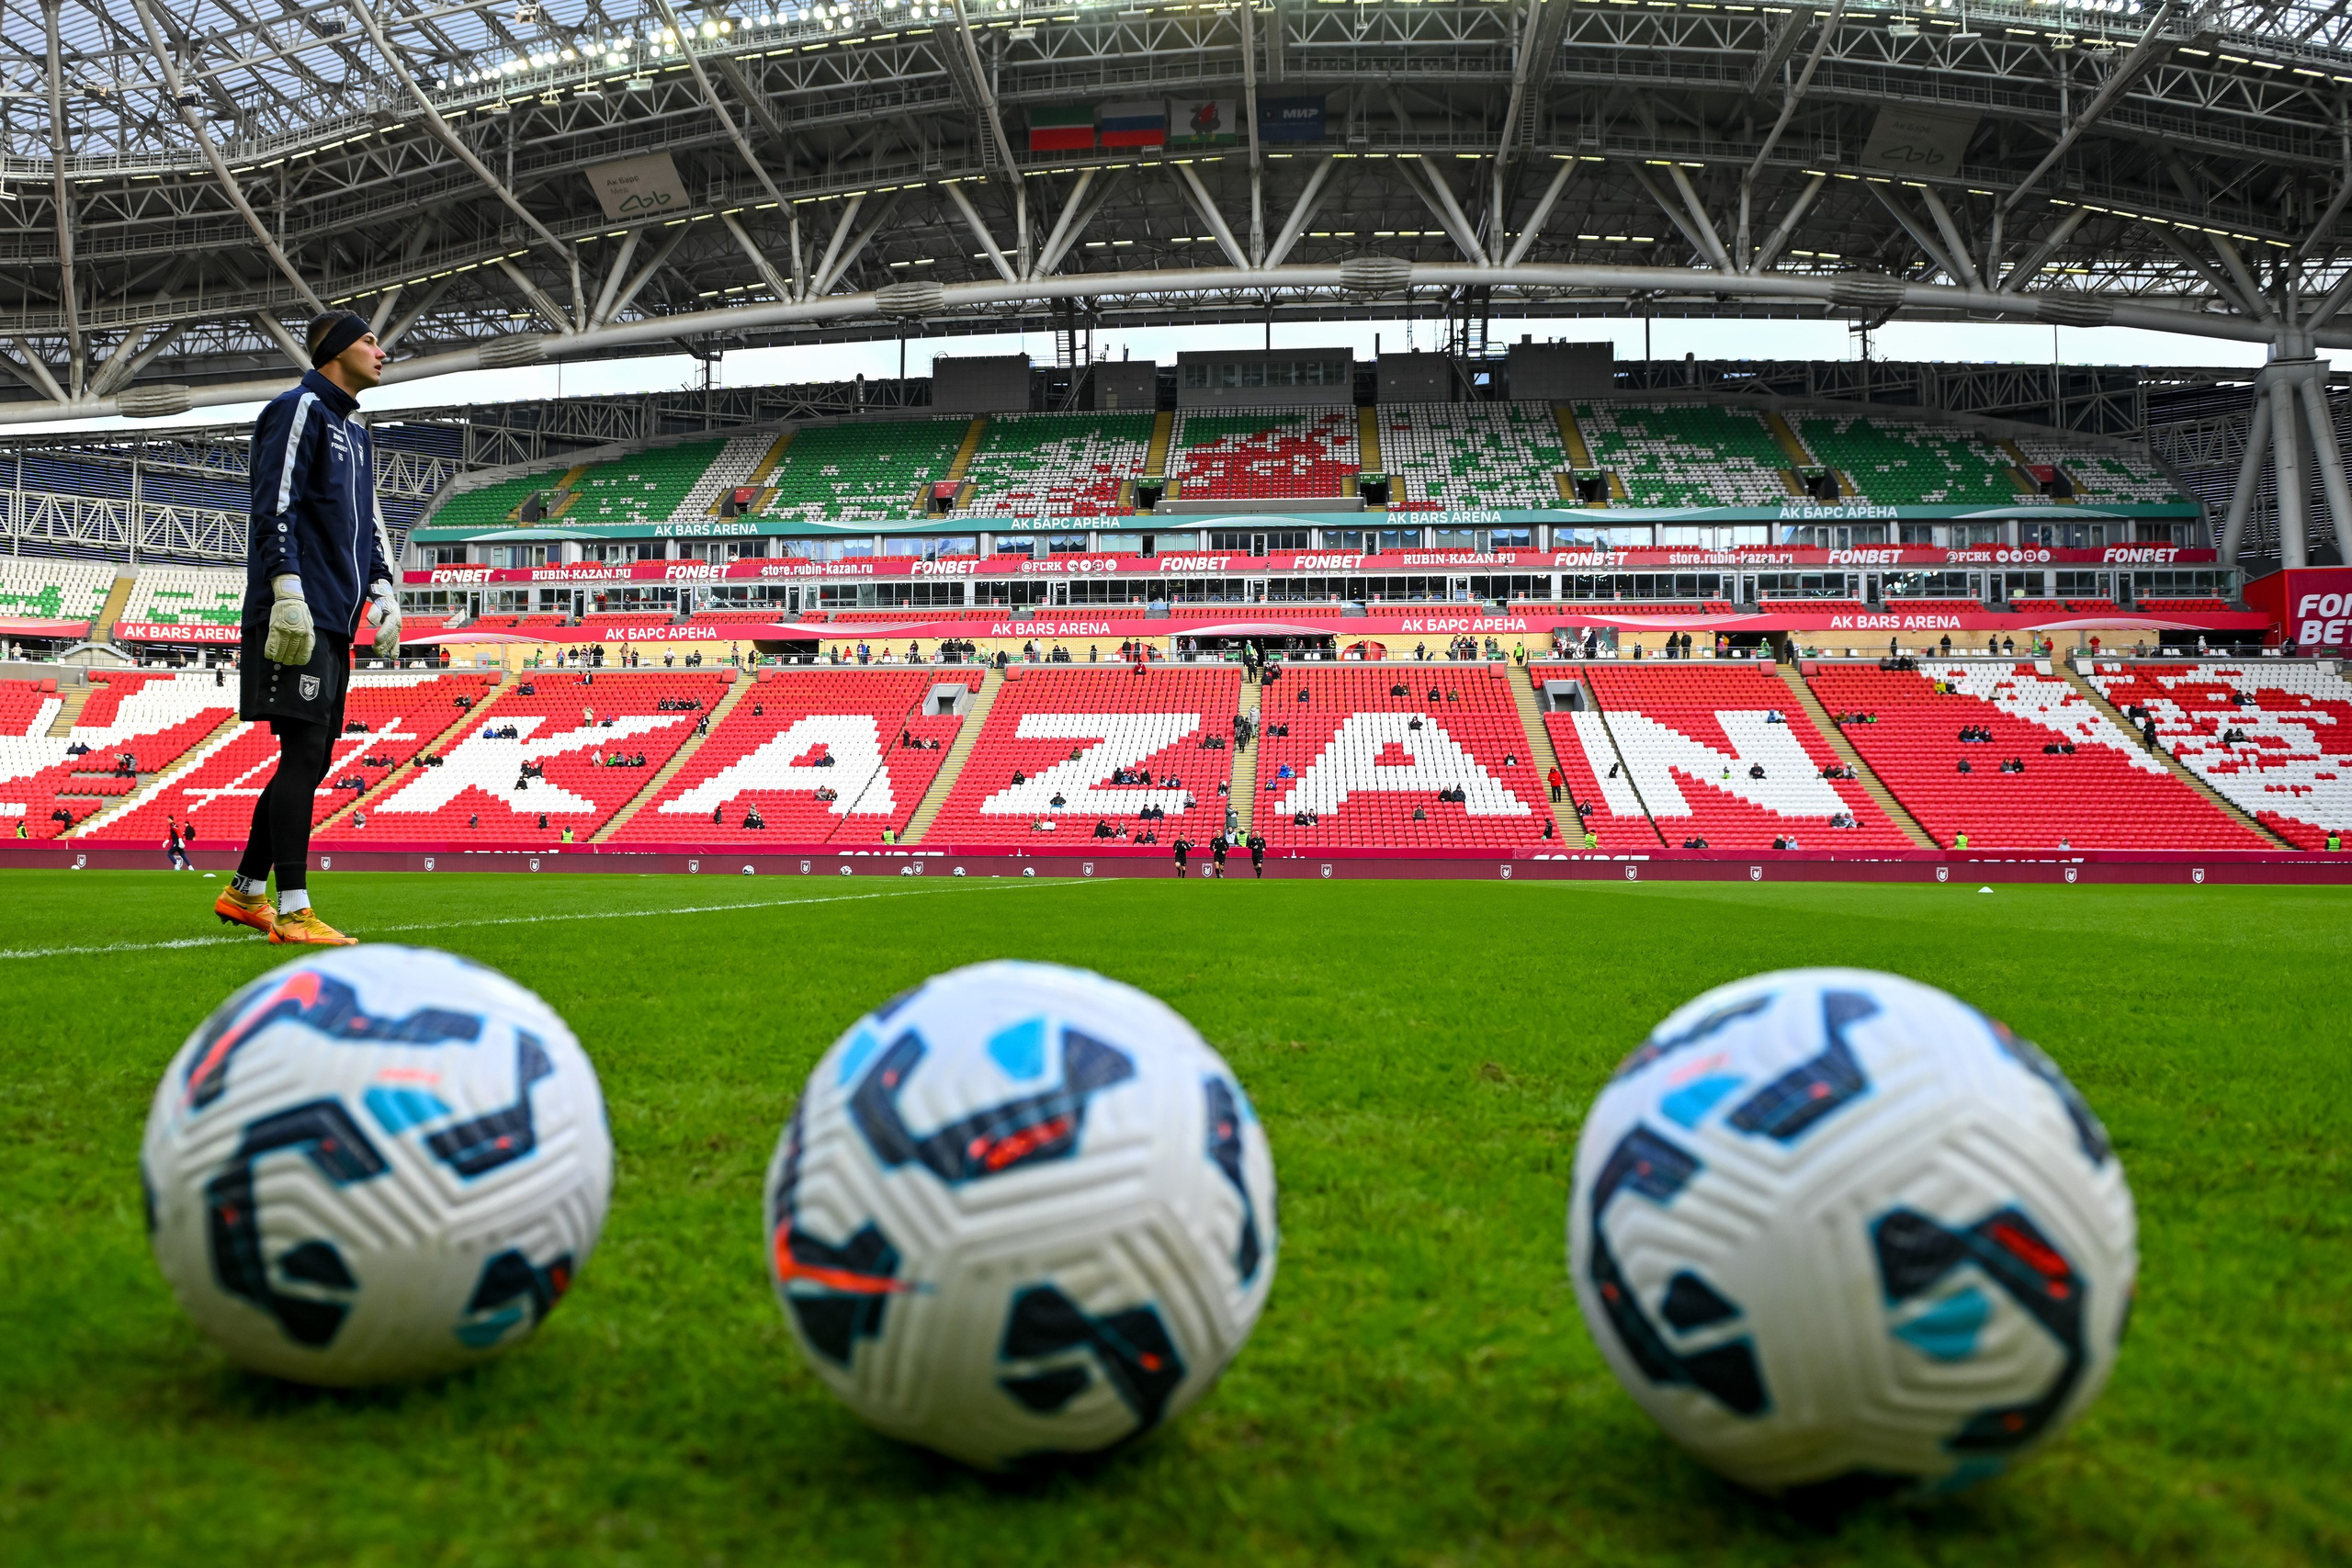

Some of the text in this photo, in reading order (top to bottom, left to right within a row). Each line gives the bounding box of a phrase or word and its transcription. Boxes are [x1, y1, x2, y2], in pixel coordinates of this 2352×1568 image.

[1283, 108, 1318, 118] МИР
[606, 175, 639, 186] Ак Барс
[1387, 511, 1501, 525] AK BARS ARENA
[1780, 505, 1898, 519] АК БАРС АРЕНА
[654, 524, 758, 536] AK BARS ARENA
[1011, 516, 1121, 530] АК БАРС АРЕНА
[1403, 553, 1516, 564] RUBIN-KAZAN.RU
[1554, 551, 1628, 566] FONBET
[1668, 551, 1793, 564] store.rubin-kazan.ru
[1828, 549, 1904, 564] FONBET
[1947, 551, 1992, 563] @FCRK
[2103, 547, 2179, 563] FONBET
[762, 562, 873, 576] store.rubin-kazan.ru
[910, 560, 978, 575] FONBET
[1021, 561, 1062, 573] @FCRK
[1160, 557, 1230, 571] FONBET
[1294, 555, 1365, 570] FONBET
[430, 569, 493, 583] FONBET
[665, 565, 731, 580] FONBET
[991, 622, 1111, 636] AK BARS ARENA
[1401, 618, 1527, 632] АК БАРС АРЕНА
[1831, 615, 1961, 629] AK BARS ARENA
[124, 625, 145, 637] AK
[150, 626, 191, 638] BARS
[605, 626, 718, 640] АК БАРС АРЕНА
[2299, 619, 2352, 645] BE
[373, 710, 1855, 818] KAZAN
